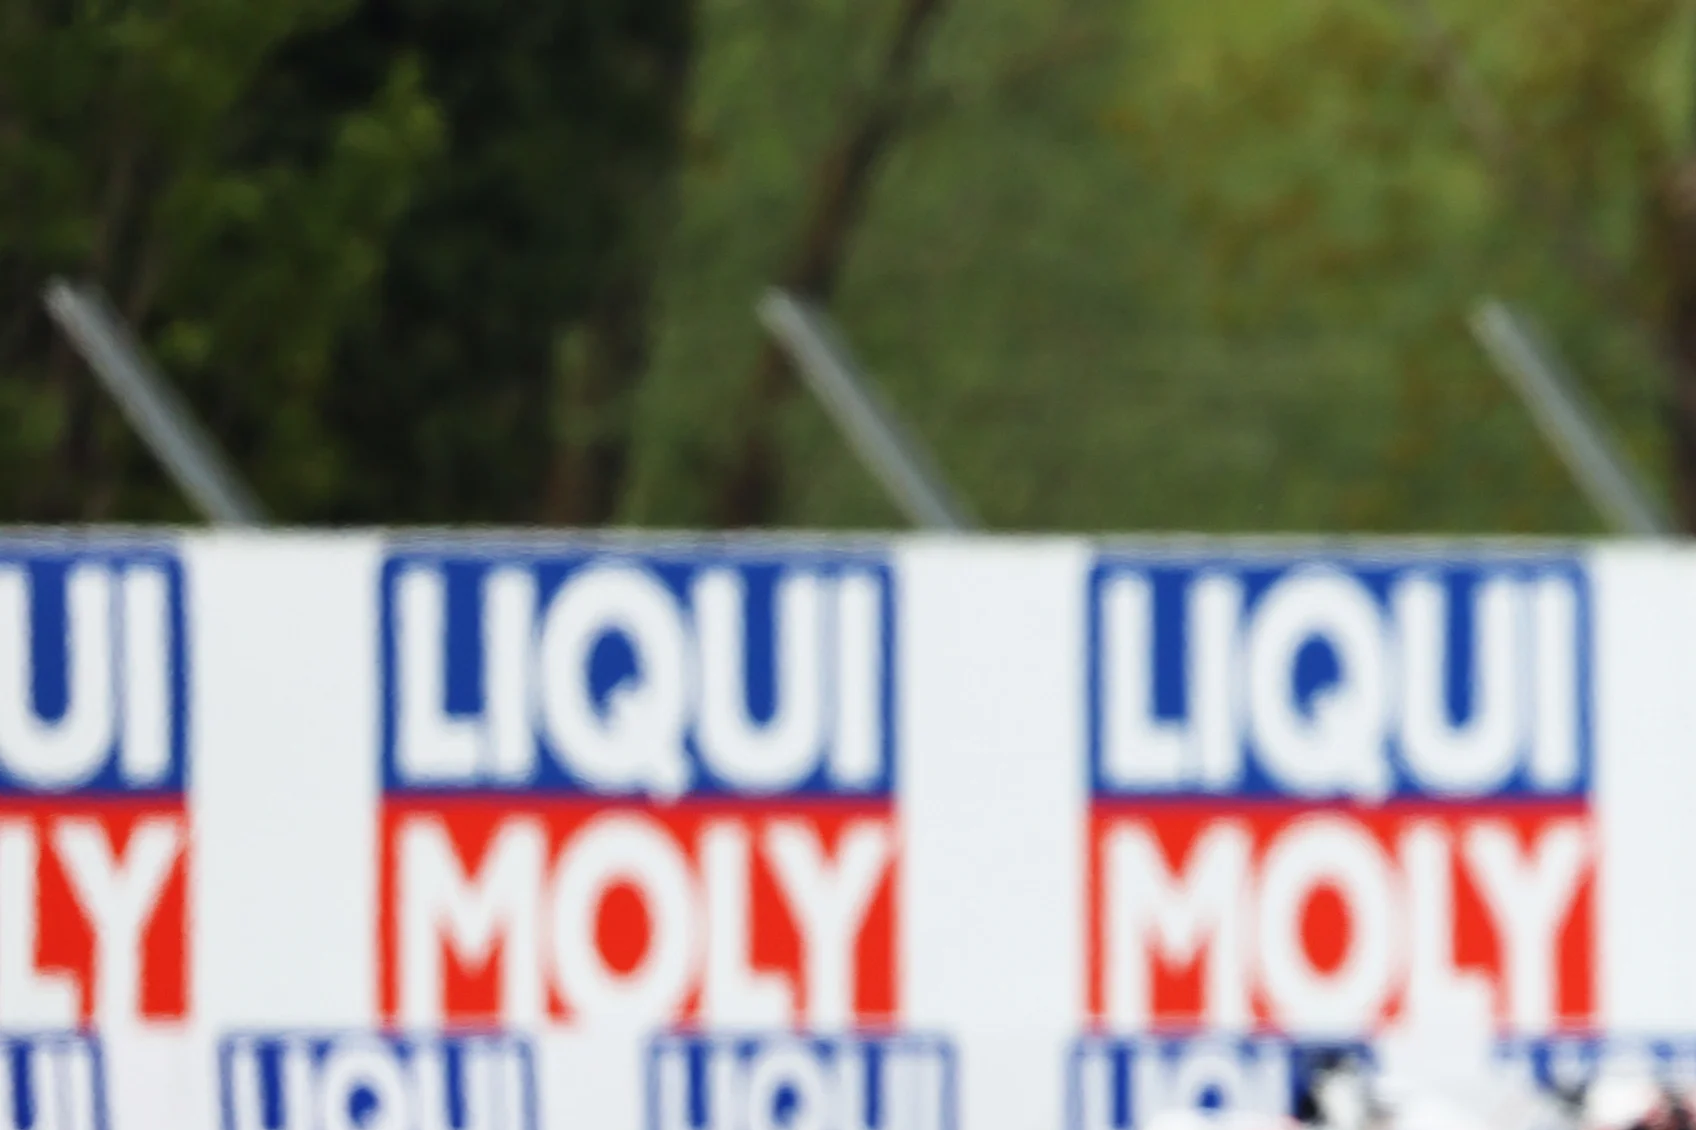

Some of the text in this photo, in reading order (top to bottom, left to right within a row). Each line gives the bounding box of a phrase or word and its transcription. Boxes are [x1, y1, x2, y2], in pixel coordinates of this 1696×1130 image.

[398, 560, 884, 801] LIQUI
[1099, 564, 1578, 803] LIQUI
[400, 811, 888, 1027] MOLY
[1103, 812, 1588, 1030] MOLY
